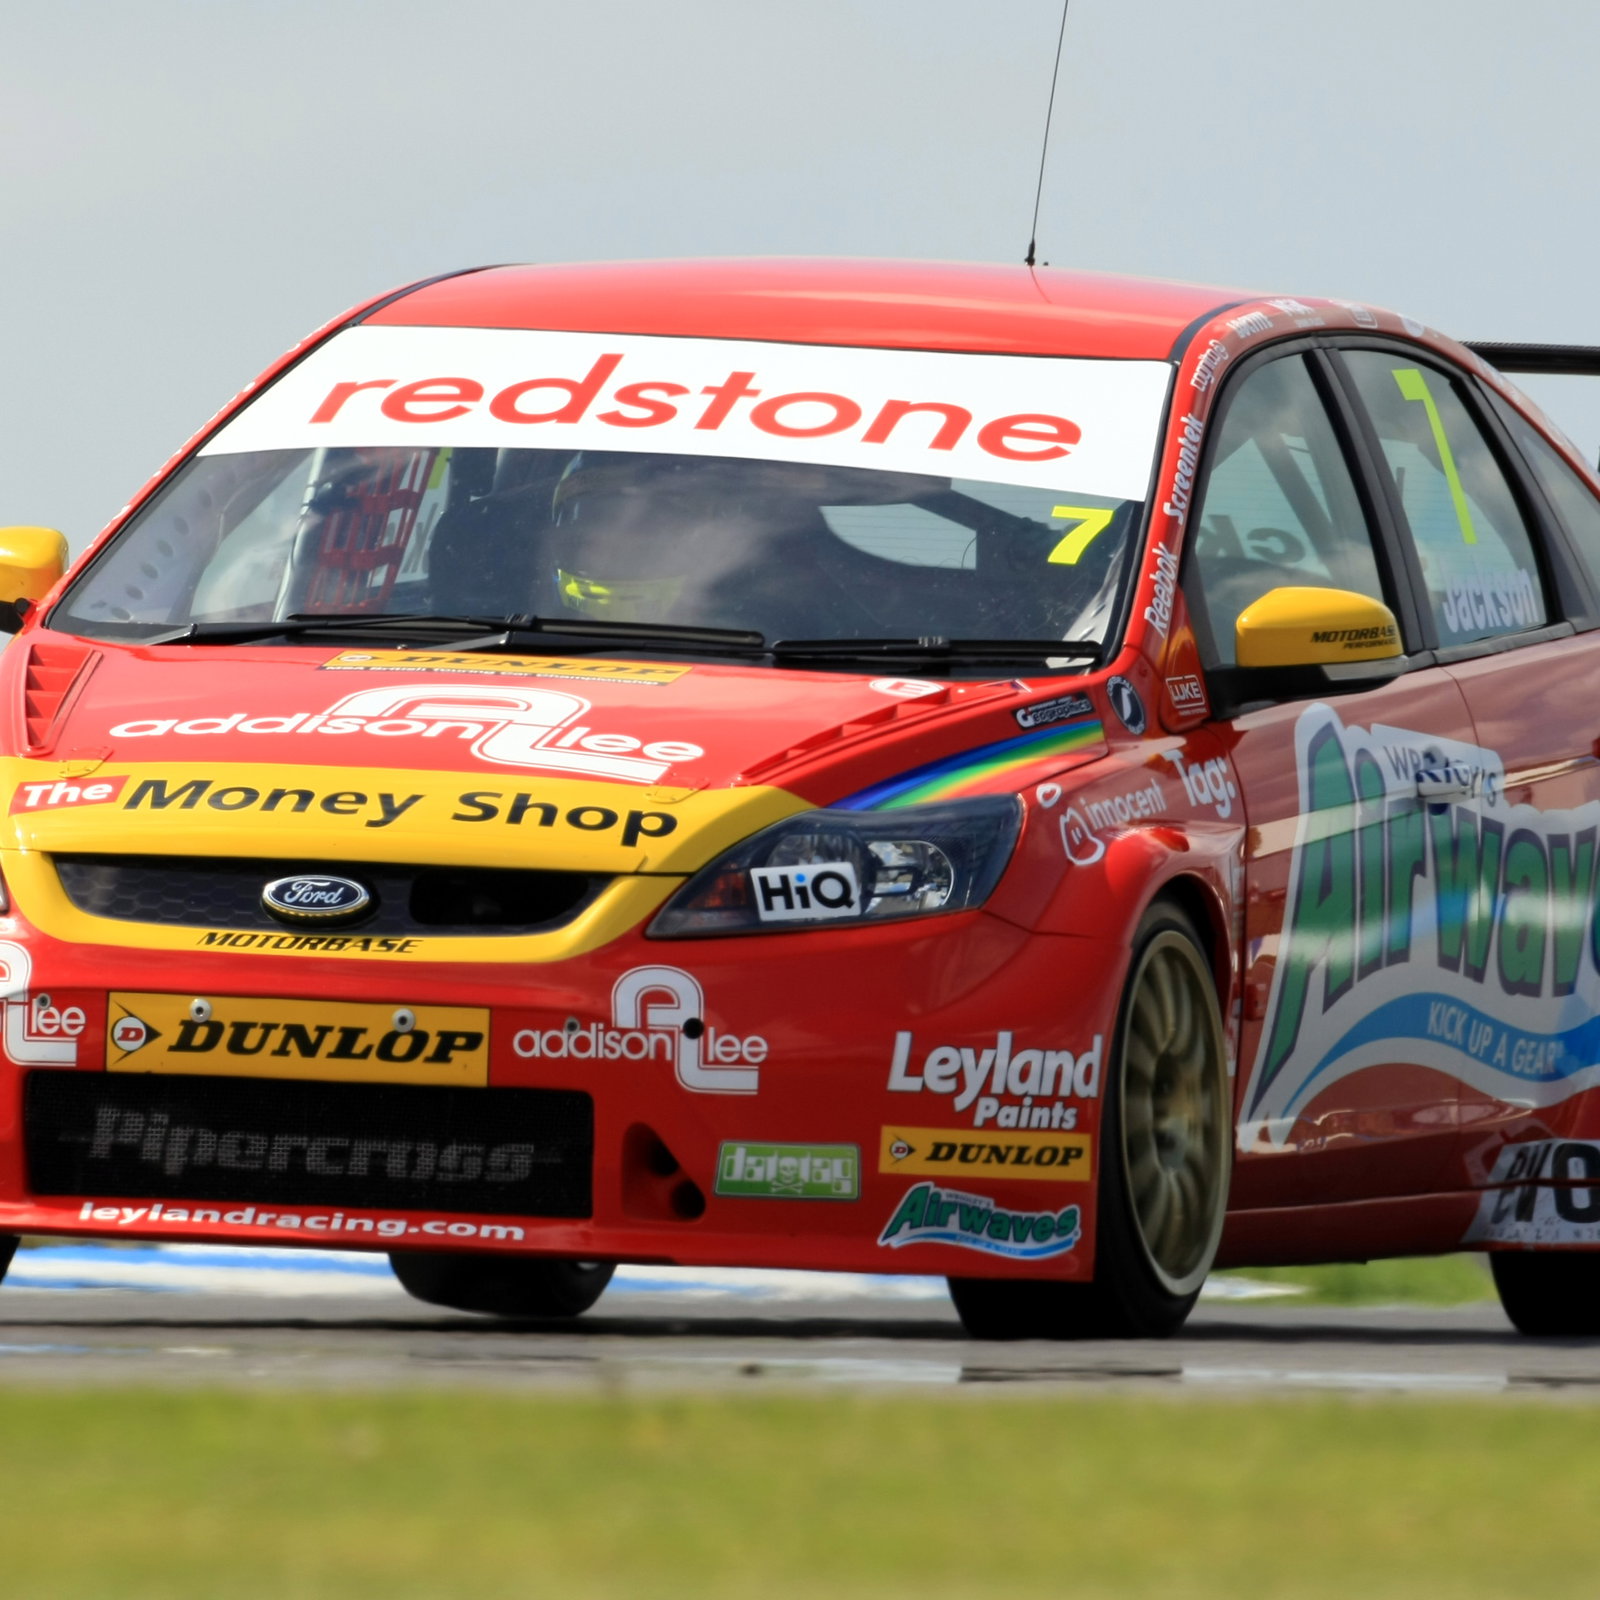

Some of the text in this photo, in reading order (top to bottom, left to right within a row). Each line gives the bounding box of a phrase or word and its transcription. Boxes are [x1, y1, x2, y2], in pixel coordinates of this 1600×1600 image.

[308, 353, 1083, 461] redstone
[1163, 412, 1204, 525] Screentek
[1390, 367, 1478, 546] 7
[1047, 505, 1115, 566] 7
[1144, 541, 1178, 638] Reebok
[1441, 564, 1540, 633] Jackson
[399, 656, 683, 676] DUNLOP
[1170, 681, 1202, 702] LUKE
[109, 711, 705, 763] addison lee
[23, 779, 679, 847] The Money Shop
[1079, 778, 1168, 830] innocent
[283, 880, 344, 905] Ford
[758, 870, 856, 912] HiQ
[196, 931, 424, 954] MOTORBASE
[1246, 721, 1600, 1122] Airwav
[31, 998, 87, 1036] lee
[167, 1018, 484, 1065] DUNLOP
[512, 1022, 768, 1064] addison lee
[1427, 1001, 1557, 1075] KICK UP A GEAR
[886, 1030, 1103, 1112] Leyland
[972, 1096, 1077, 1130] Paints
[88, 1107, 535, 1182] Pipercross
[925, 1141, 1084, 1167] DUNLOP
[78, 1201, 525, 1241] leylandracing.com
[880, 1184, 1079, 1244] Airwaves
